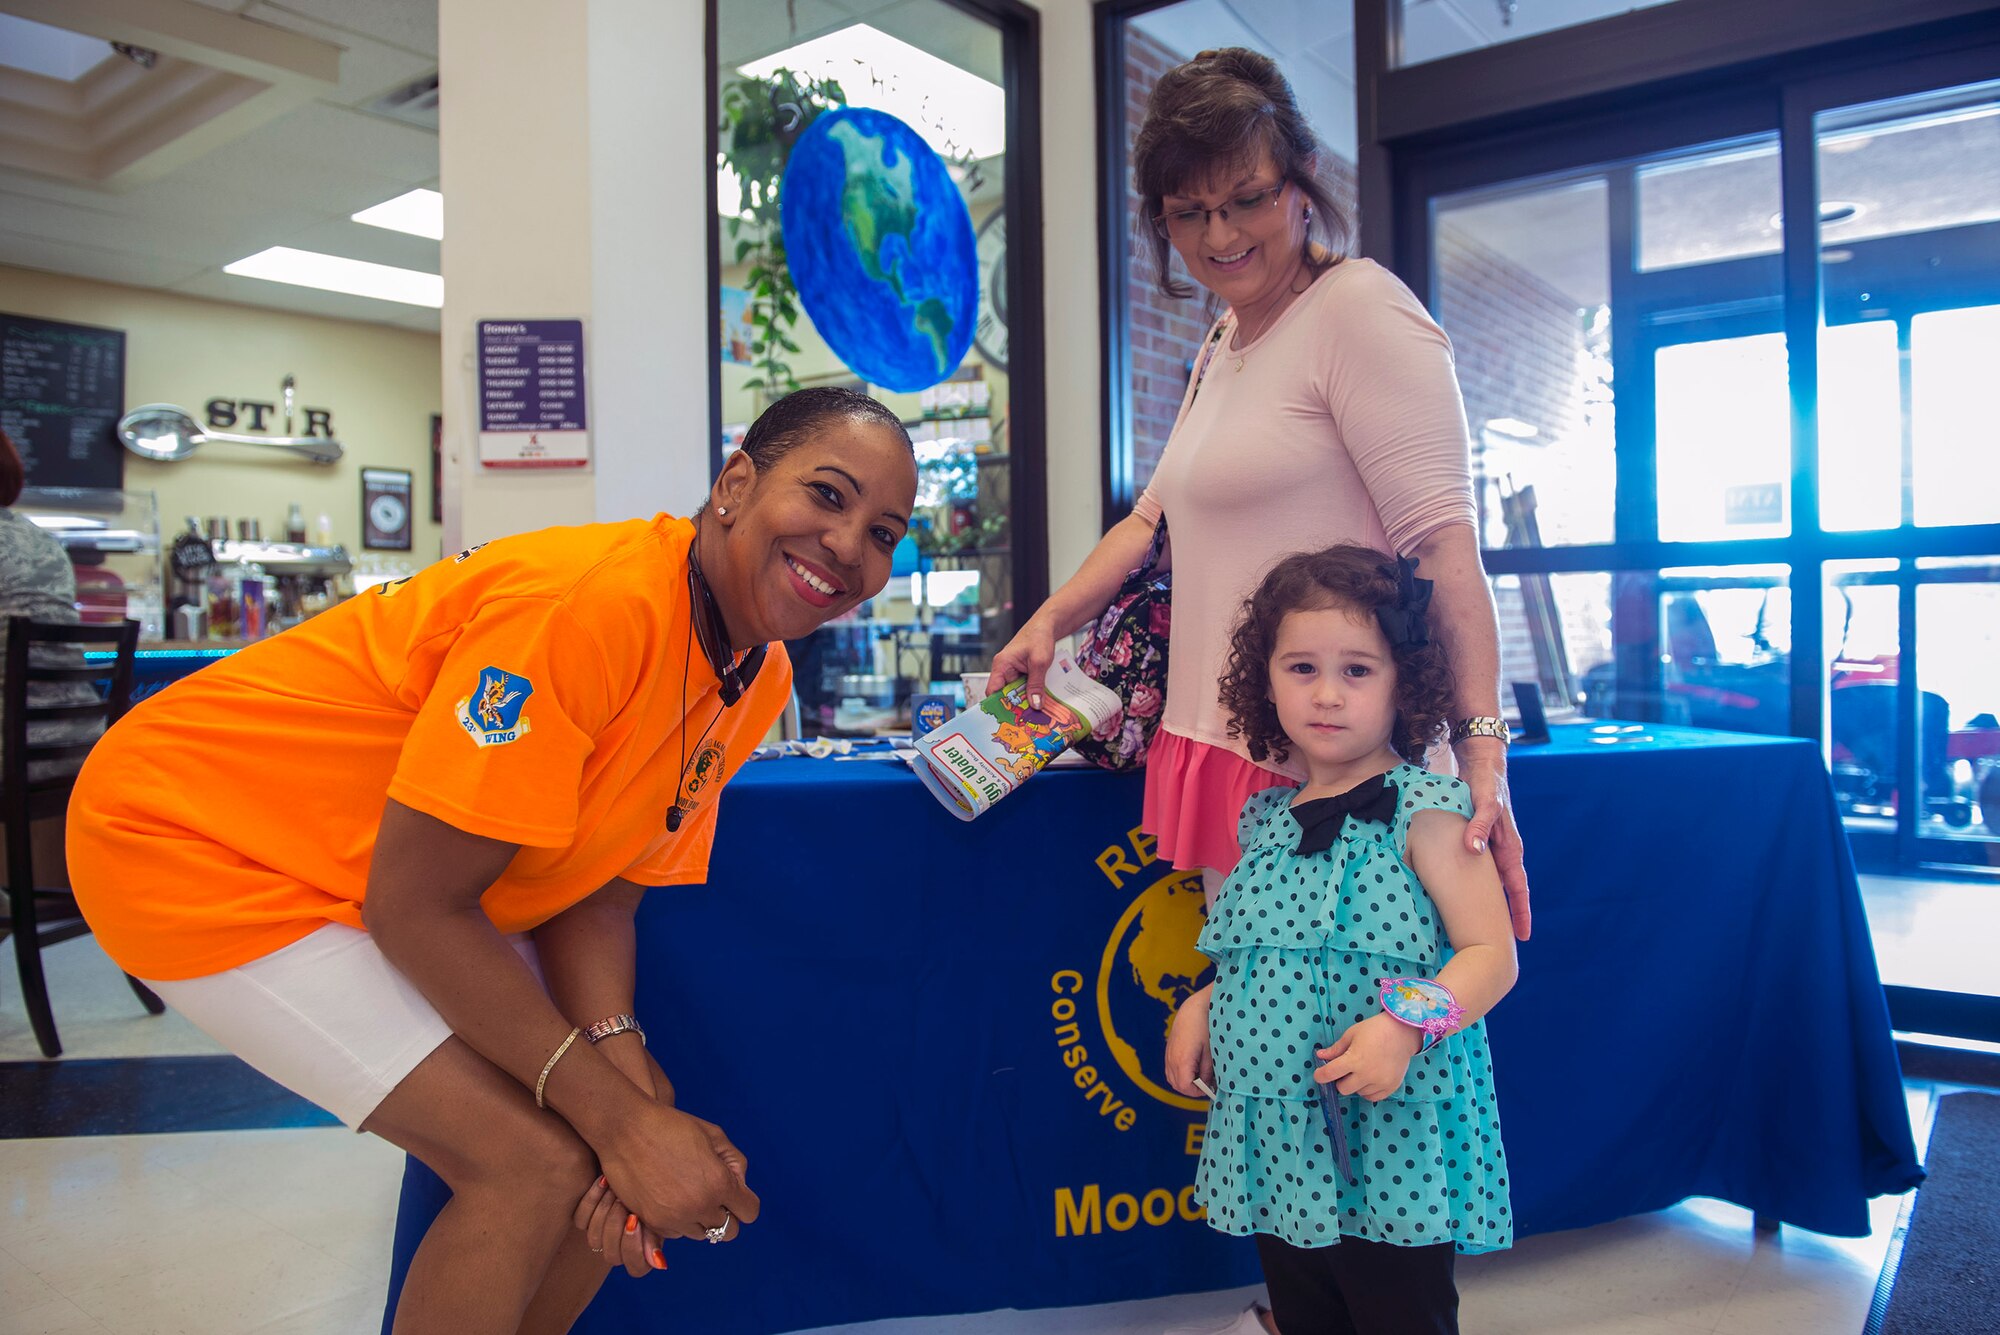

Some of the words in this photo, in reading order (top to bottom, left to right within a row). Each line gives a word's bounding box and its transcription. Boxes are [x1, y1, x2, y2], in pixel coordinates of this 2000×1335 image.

[485, 732, 516, 743] WING
[943, 747, 978, 778] Water
[976, 776, 987, 784] &
[1051, 970, 1137, 1131] Conserve
